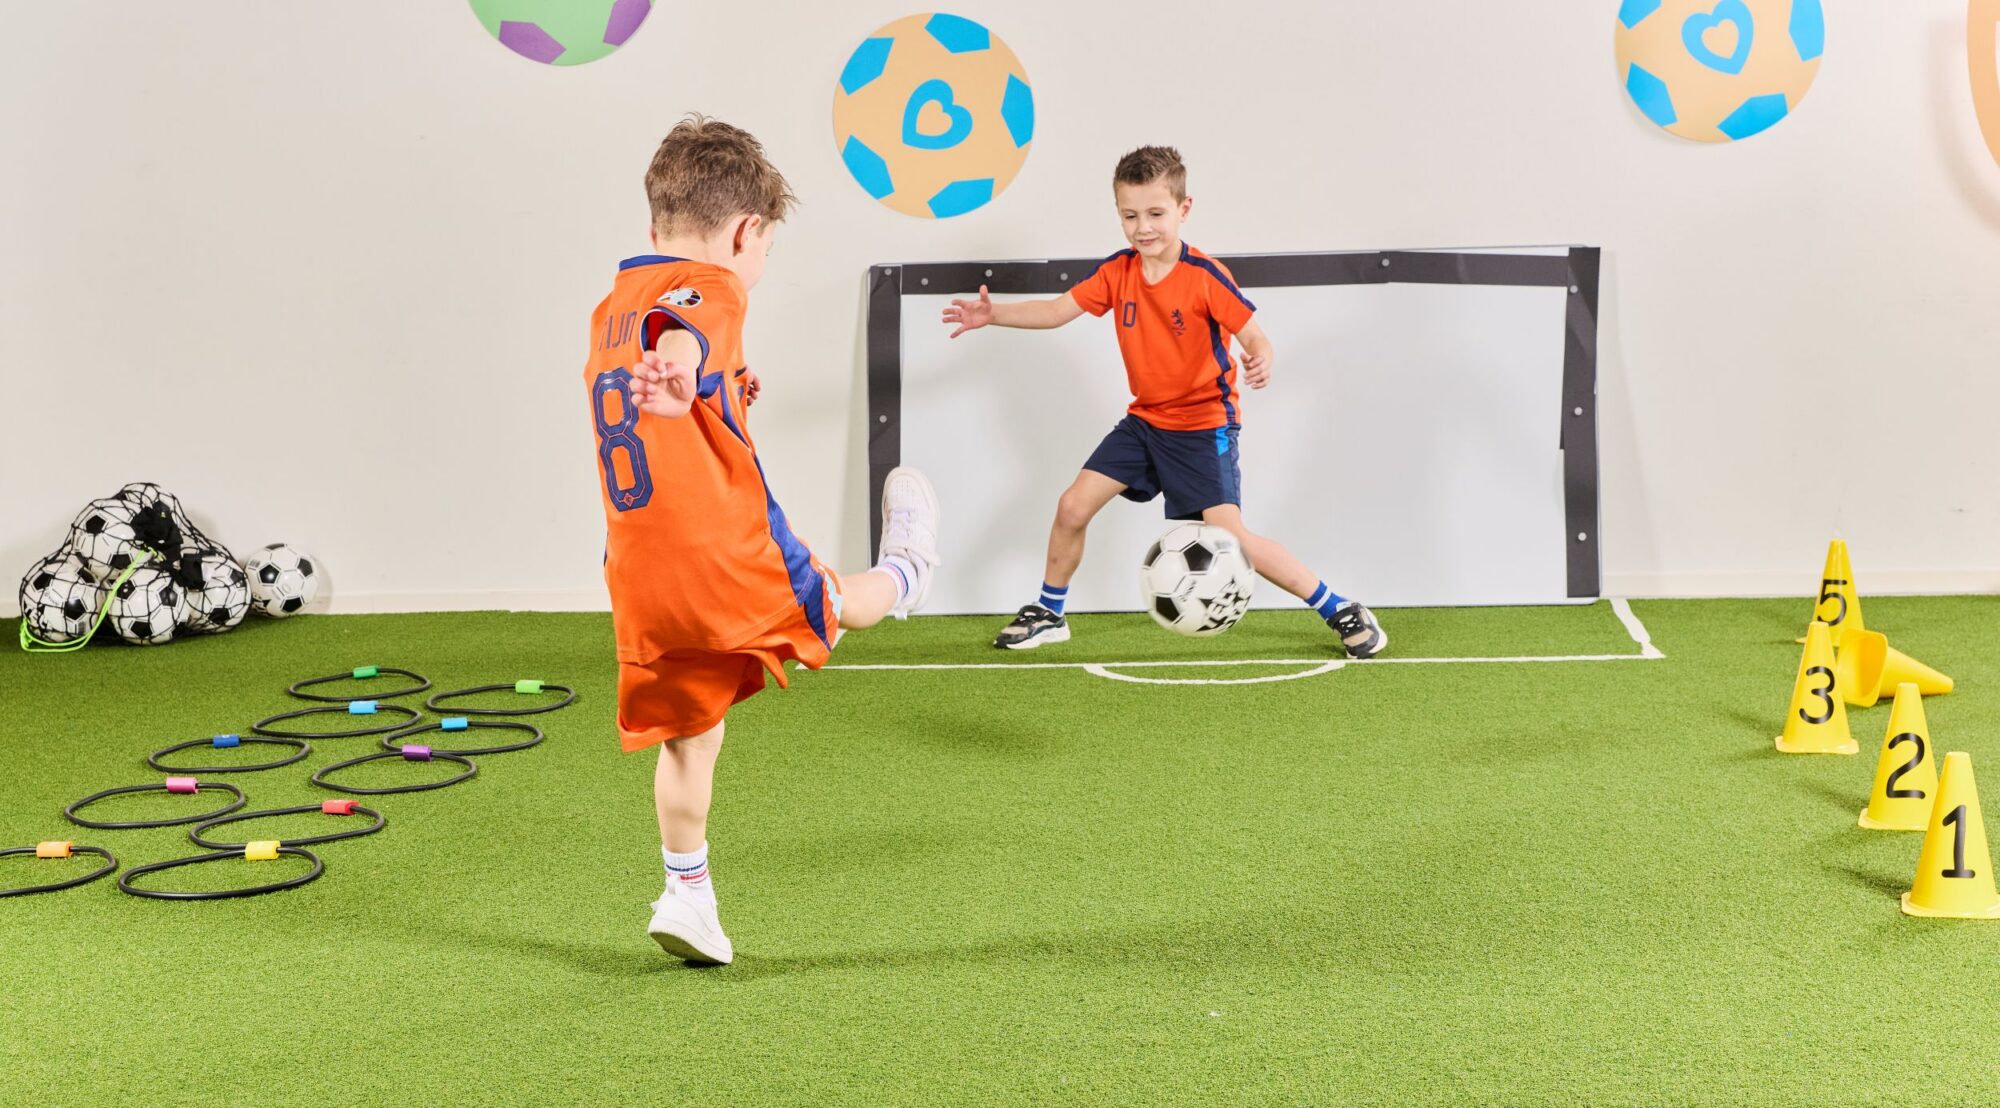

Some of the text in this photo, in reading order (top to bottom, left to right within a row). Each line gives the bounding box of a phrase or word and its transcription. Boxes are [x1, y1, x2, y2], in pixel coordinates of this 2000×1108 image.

[592, 366, 654, 512] 8
[1816, 579, 1848, 627] 5
[1799, 666, 1835, 724] 3
[1886, 732, 1926, 800] 2
[1941, 804, 1976, 879] 1
